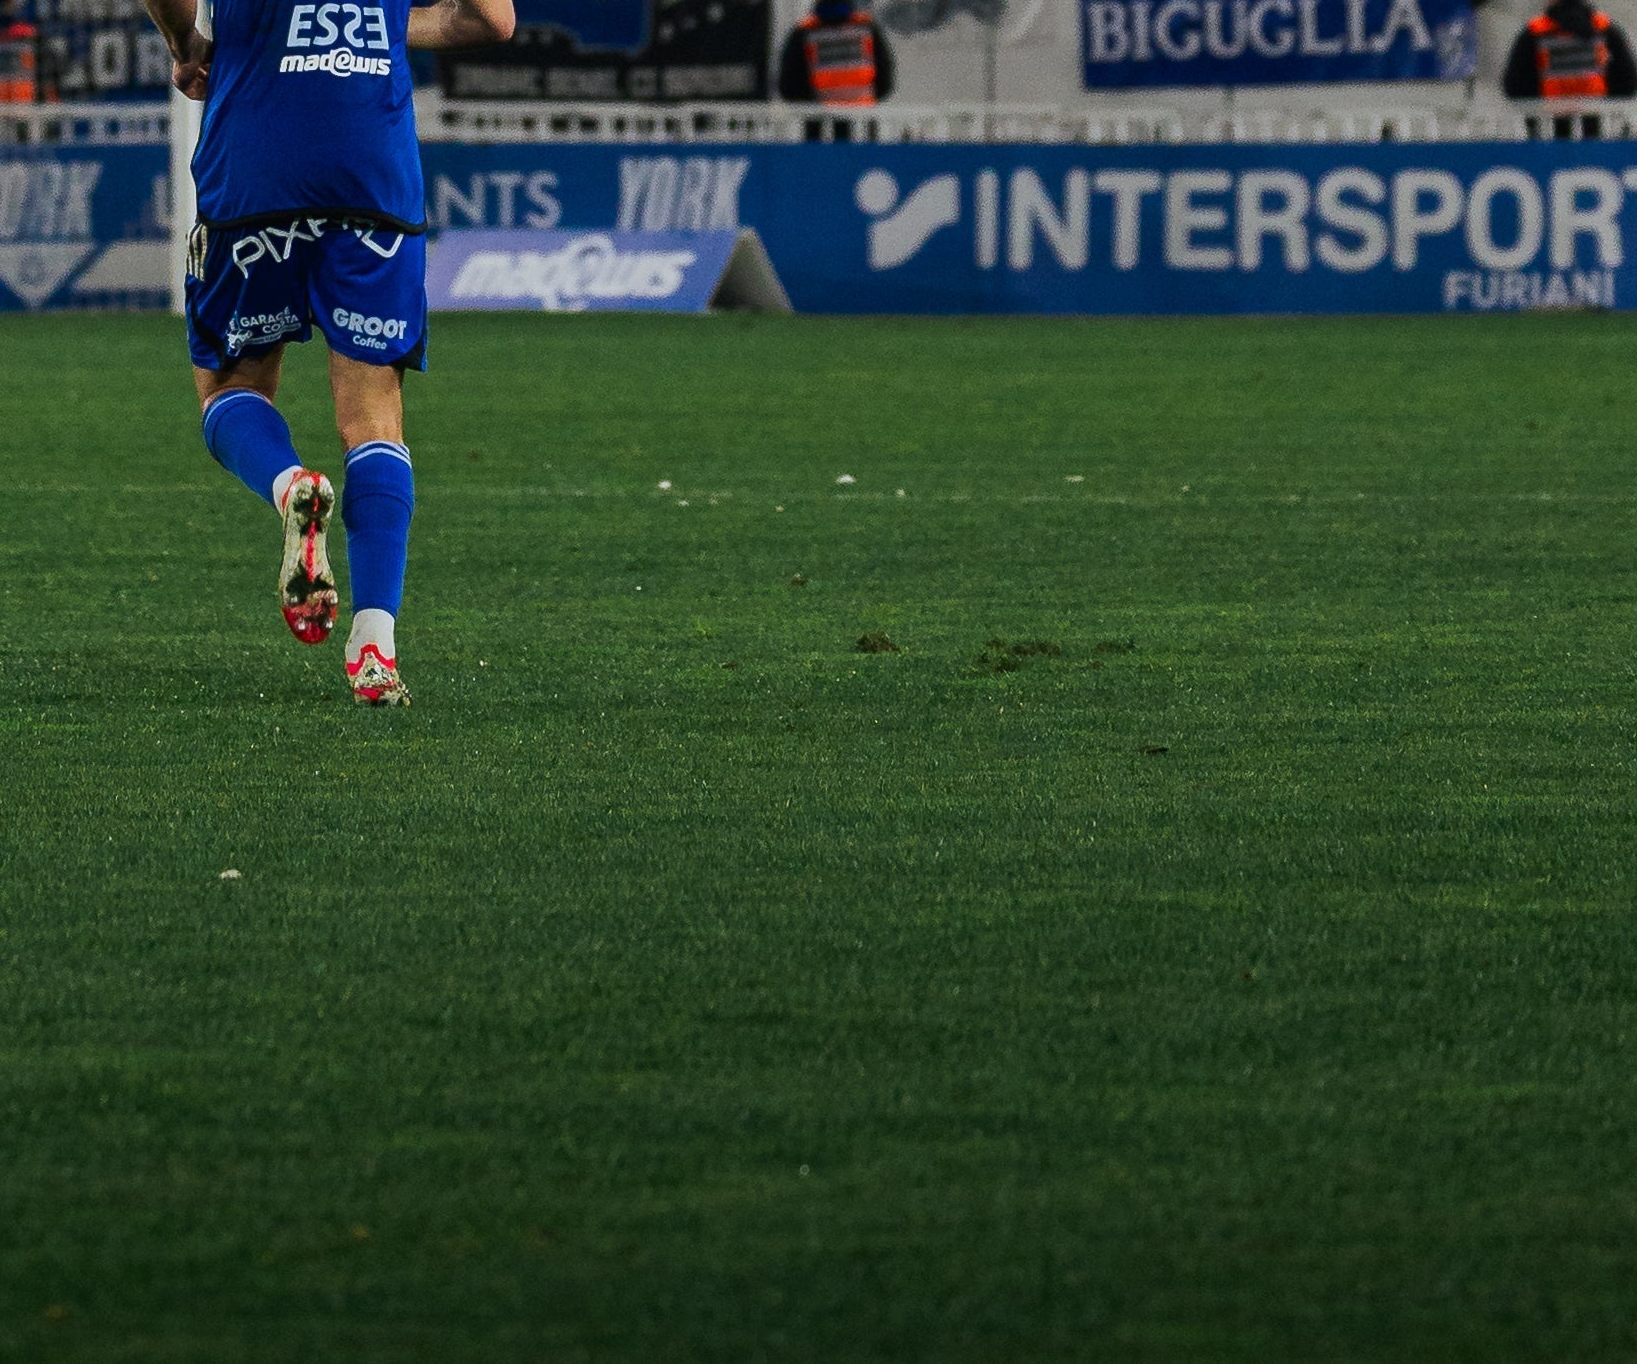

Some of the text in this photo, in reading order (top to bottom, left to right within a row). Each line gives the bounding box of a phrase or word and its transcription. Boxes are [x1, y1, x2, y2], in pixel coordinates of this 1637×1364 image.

[427, 170, 562, 228] NTS
[617, 155, 752, 230] YORK
[974, 166, 1637, 271] INTERSPOR
[1442, 270, 1615, 310] FURIANI
[332, 307, 408, 340] GROOT
[352, 334, 388, 350] Coffee
